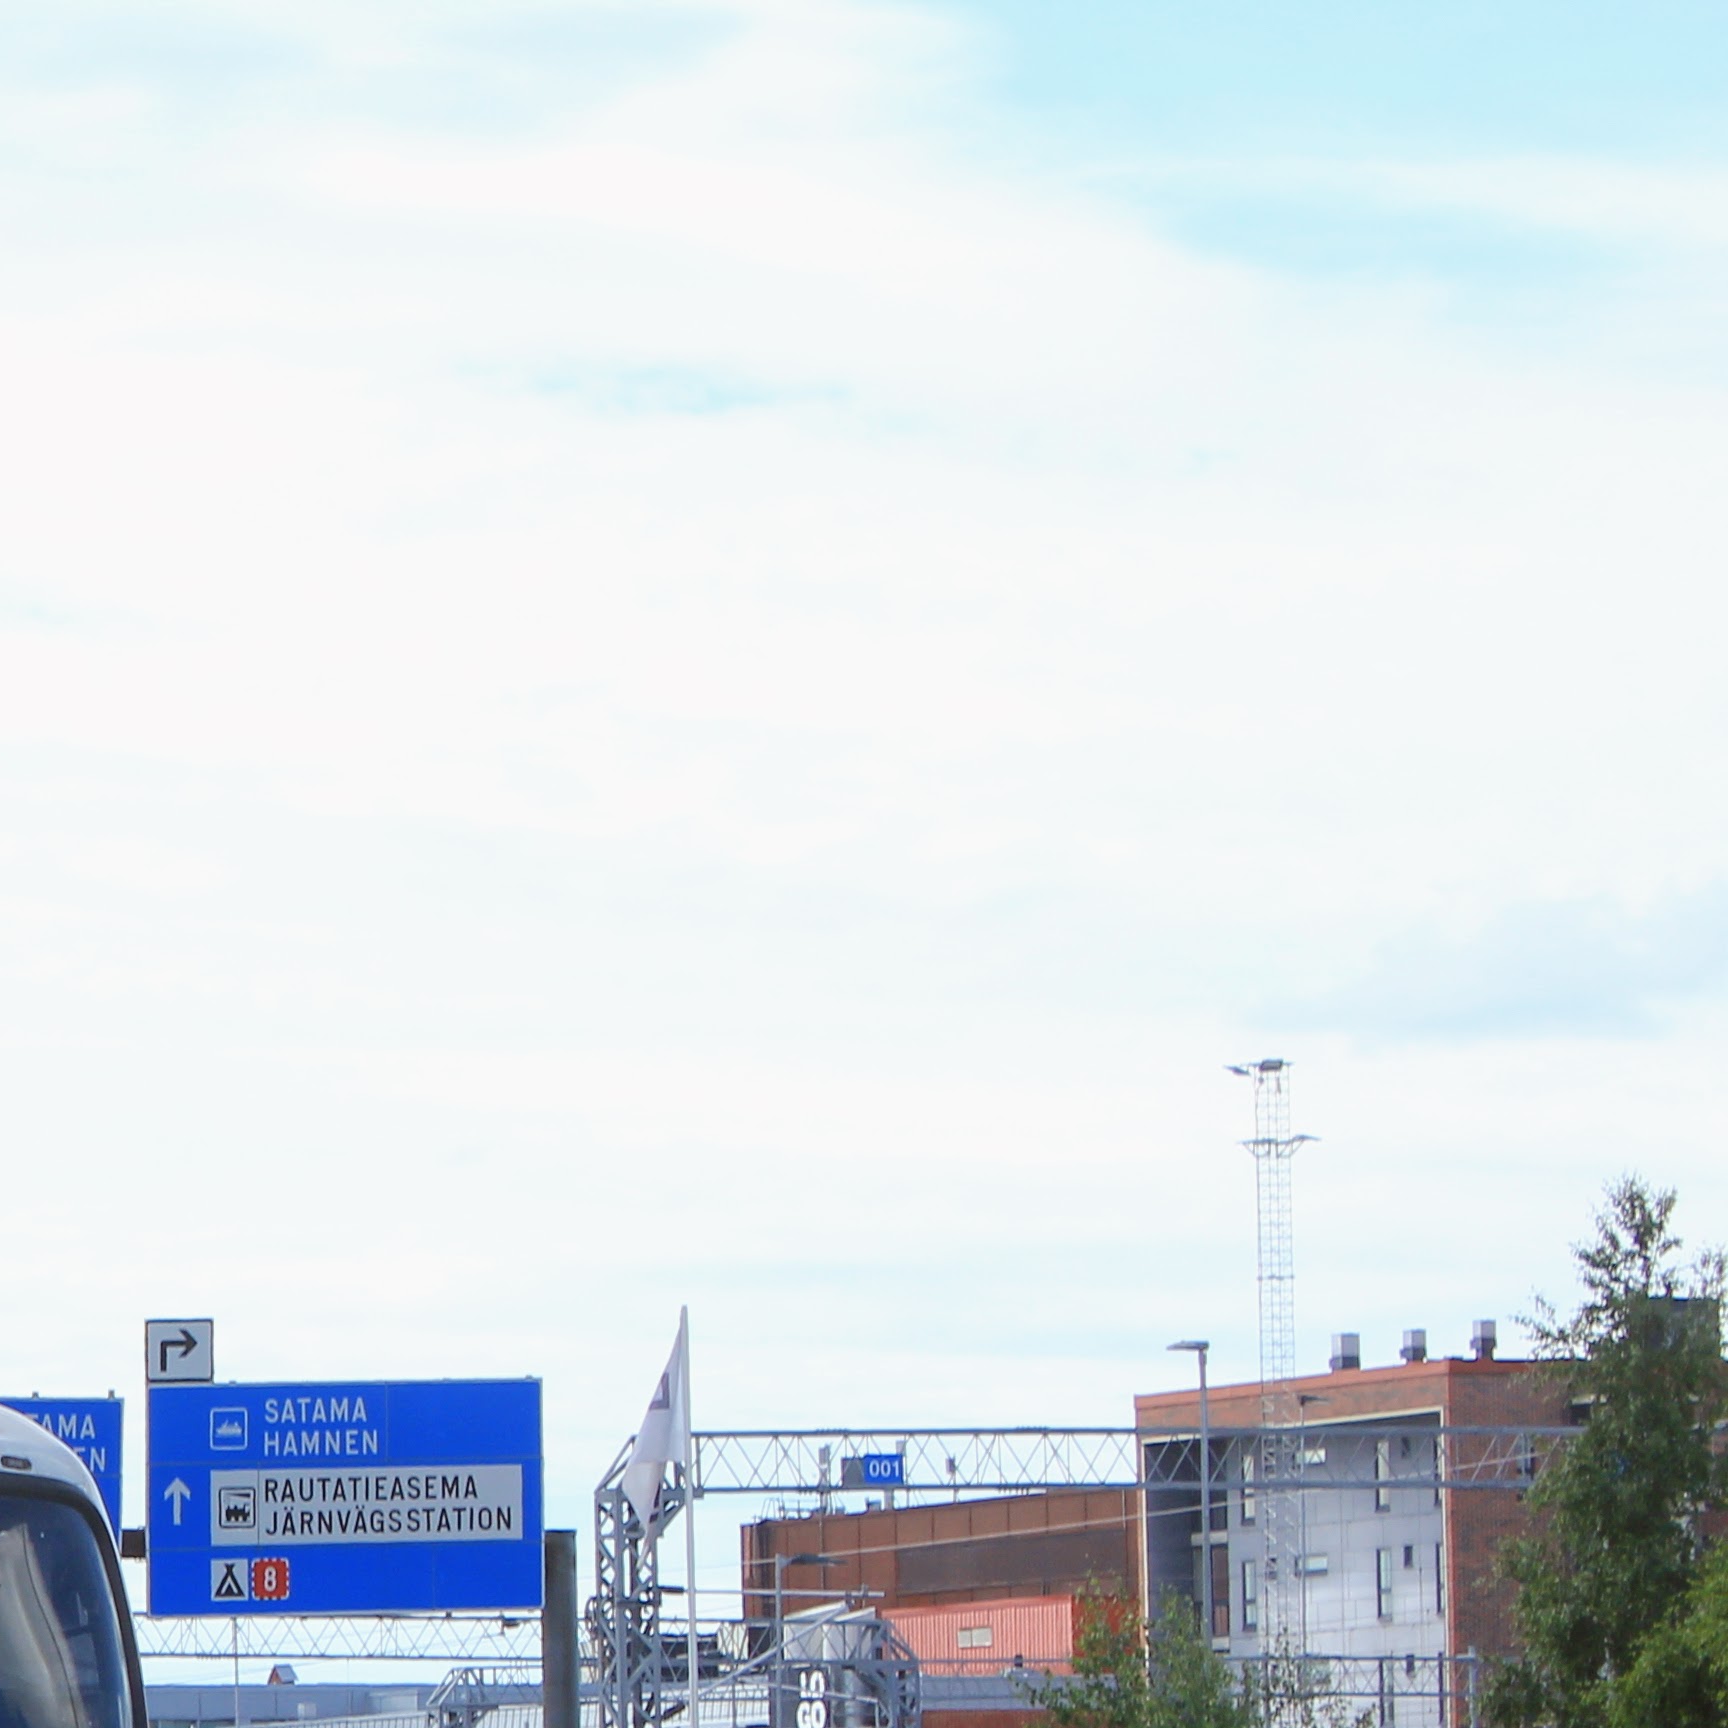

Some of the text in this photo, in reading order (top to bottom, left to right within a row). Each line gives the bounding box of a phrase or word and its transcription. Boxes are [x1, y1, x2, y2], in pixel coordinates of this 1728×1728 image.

[264, 1397, 368, 1424] SATAMA
[263, 1429, 378, 1457] HAMNEN
[868, 1459, 901, 1478] 001
[263, 1475, 478, 1504] RAUTATIEASEMA
[264, 1504, 513, 1537] JÄRNVÄGSSTATION
[264, 1565, 277, 1592] 8
